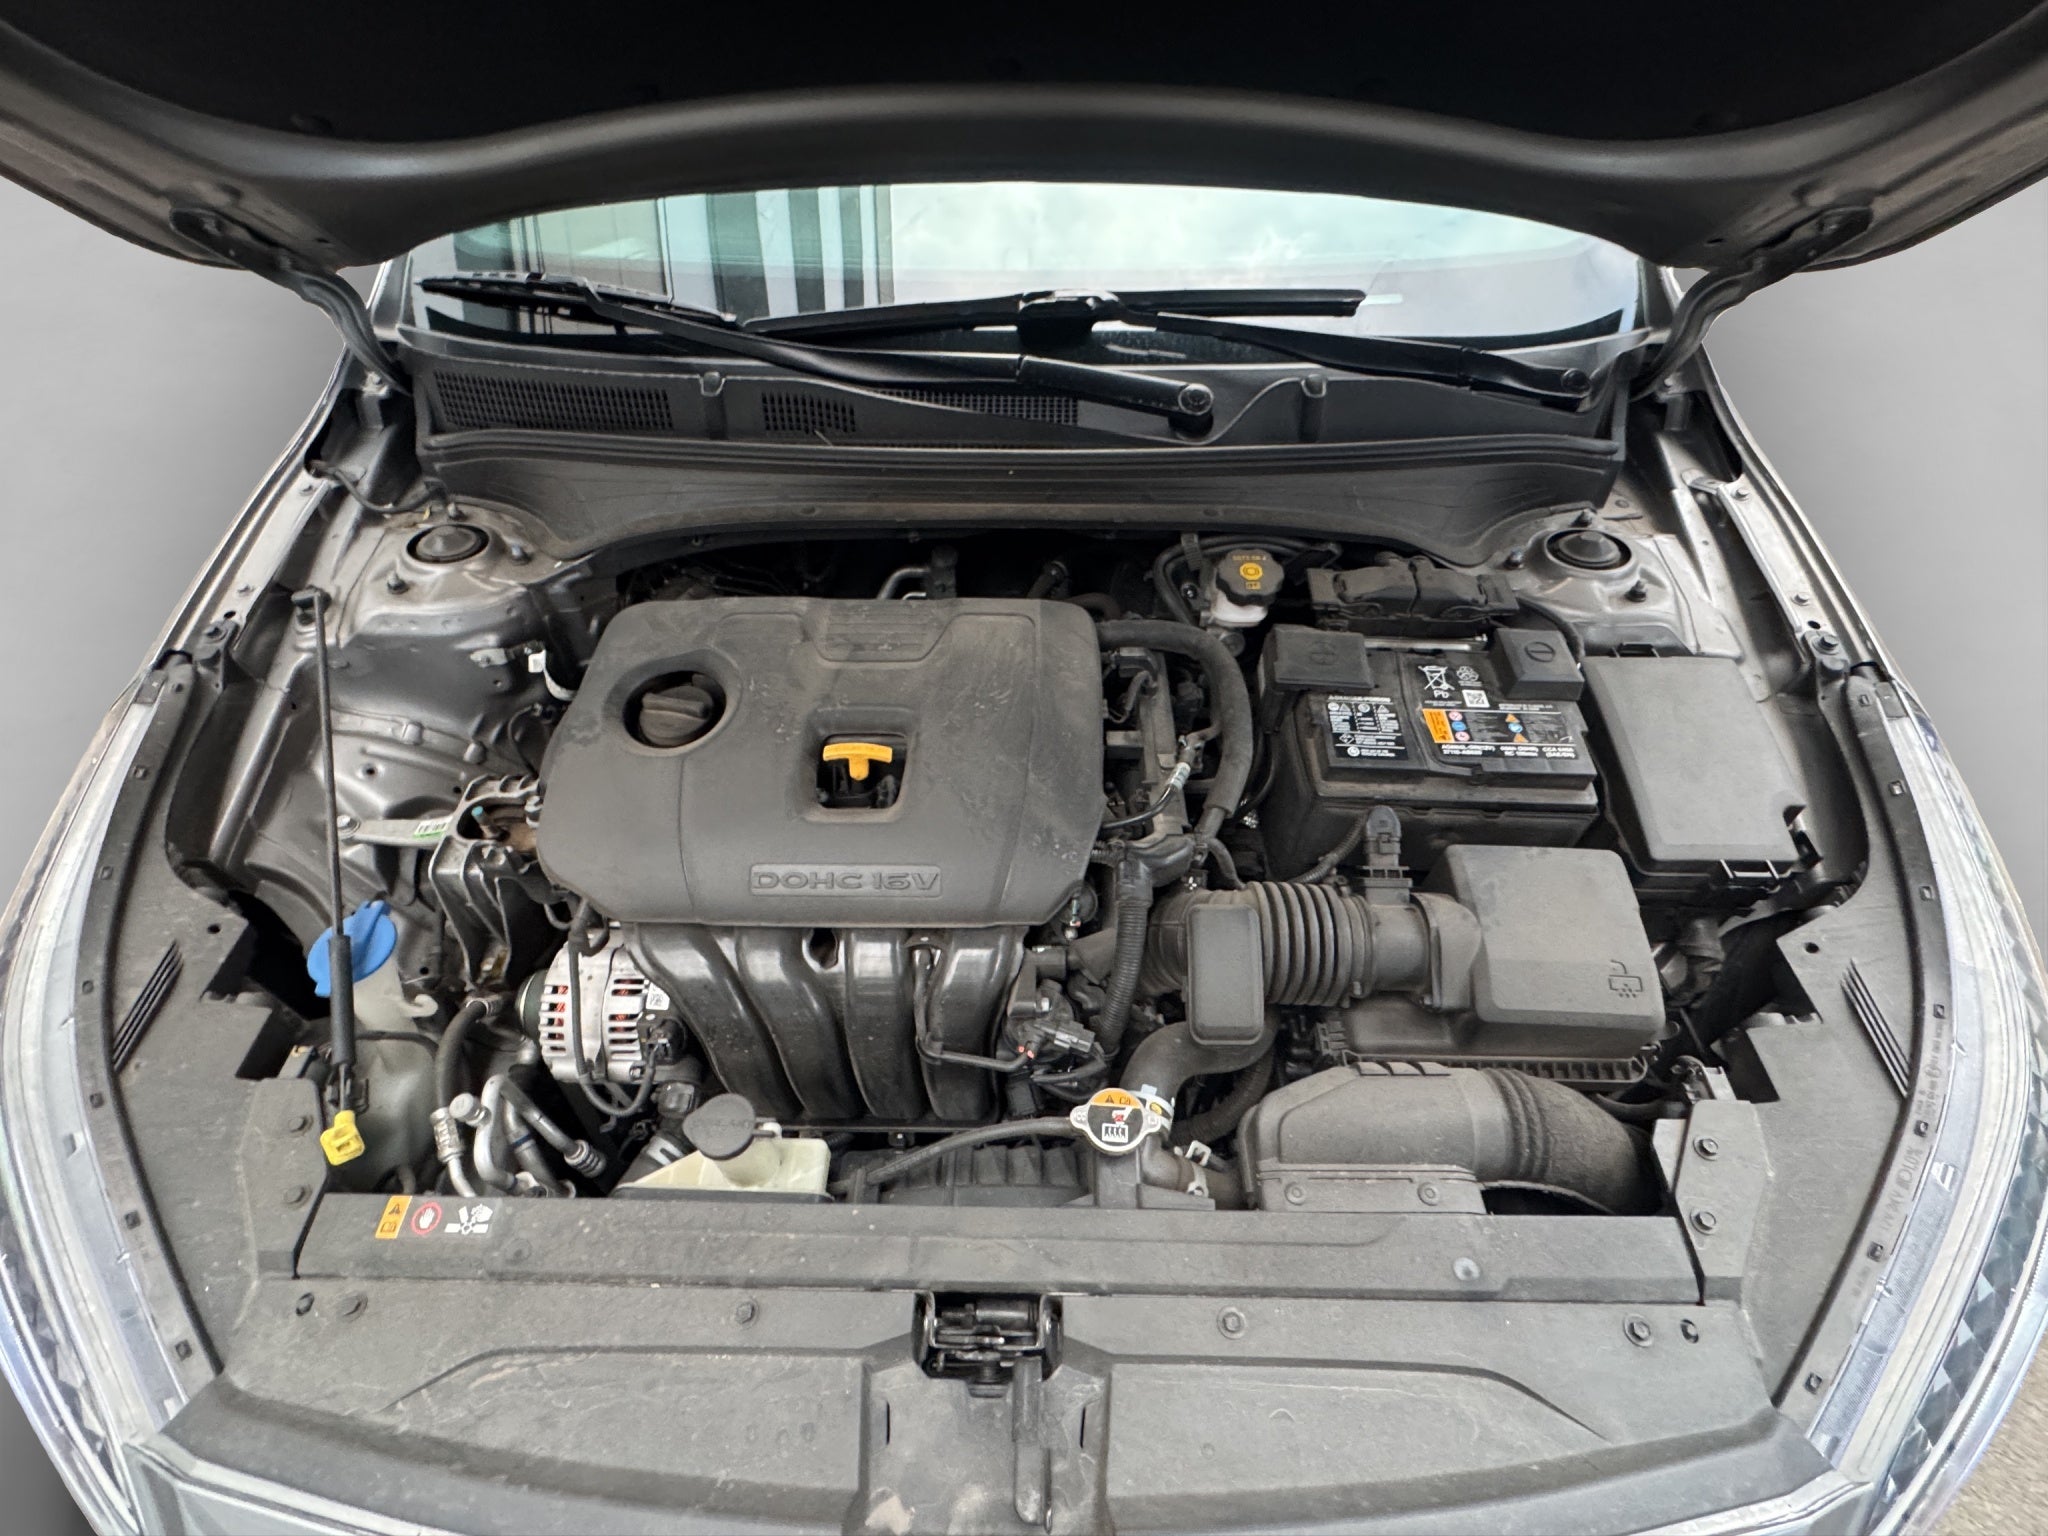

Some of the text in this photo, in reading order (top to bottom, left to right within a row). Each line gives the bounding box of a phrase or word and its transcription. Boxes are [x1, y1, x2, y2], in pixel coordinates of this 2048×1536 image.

[1433, 689, 1449, 699] Pb
[752, 871, 940, 891] DOHC 16V
